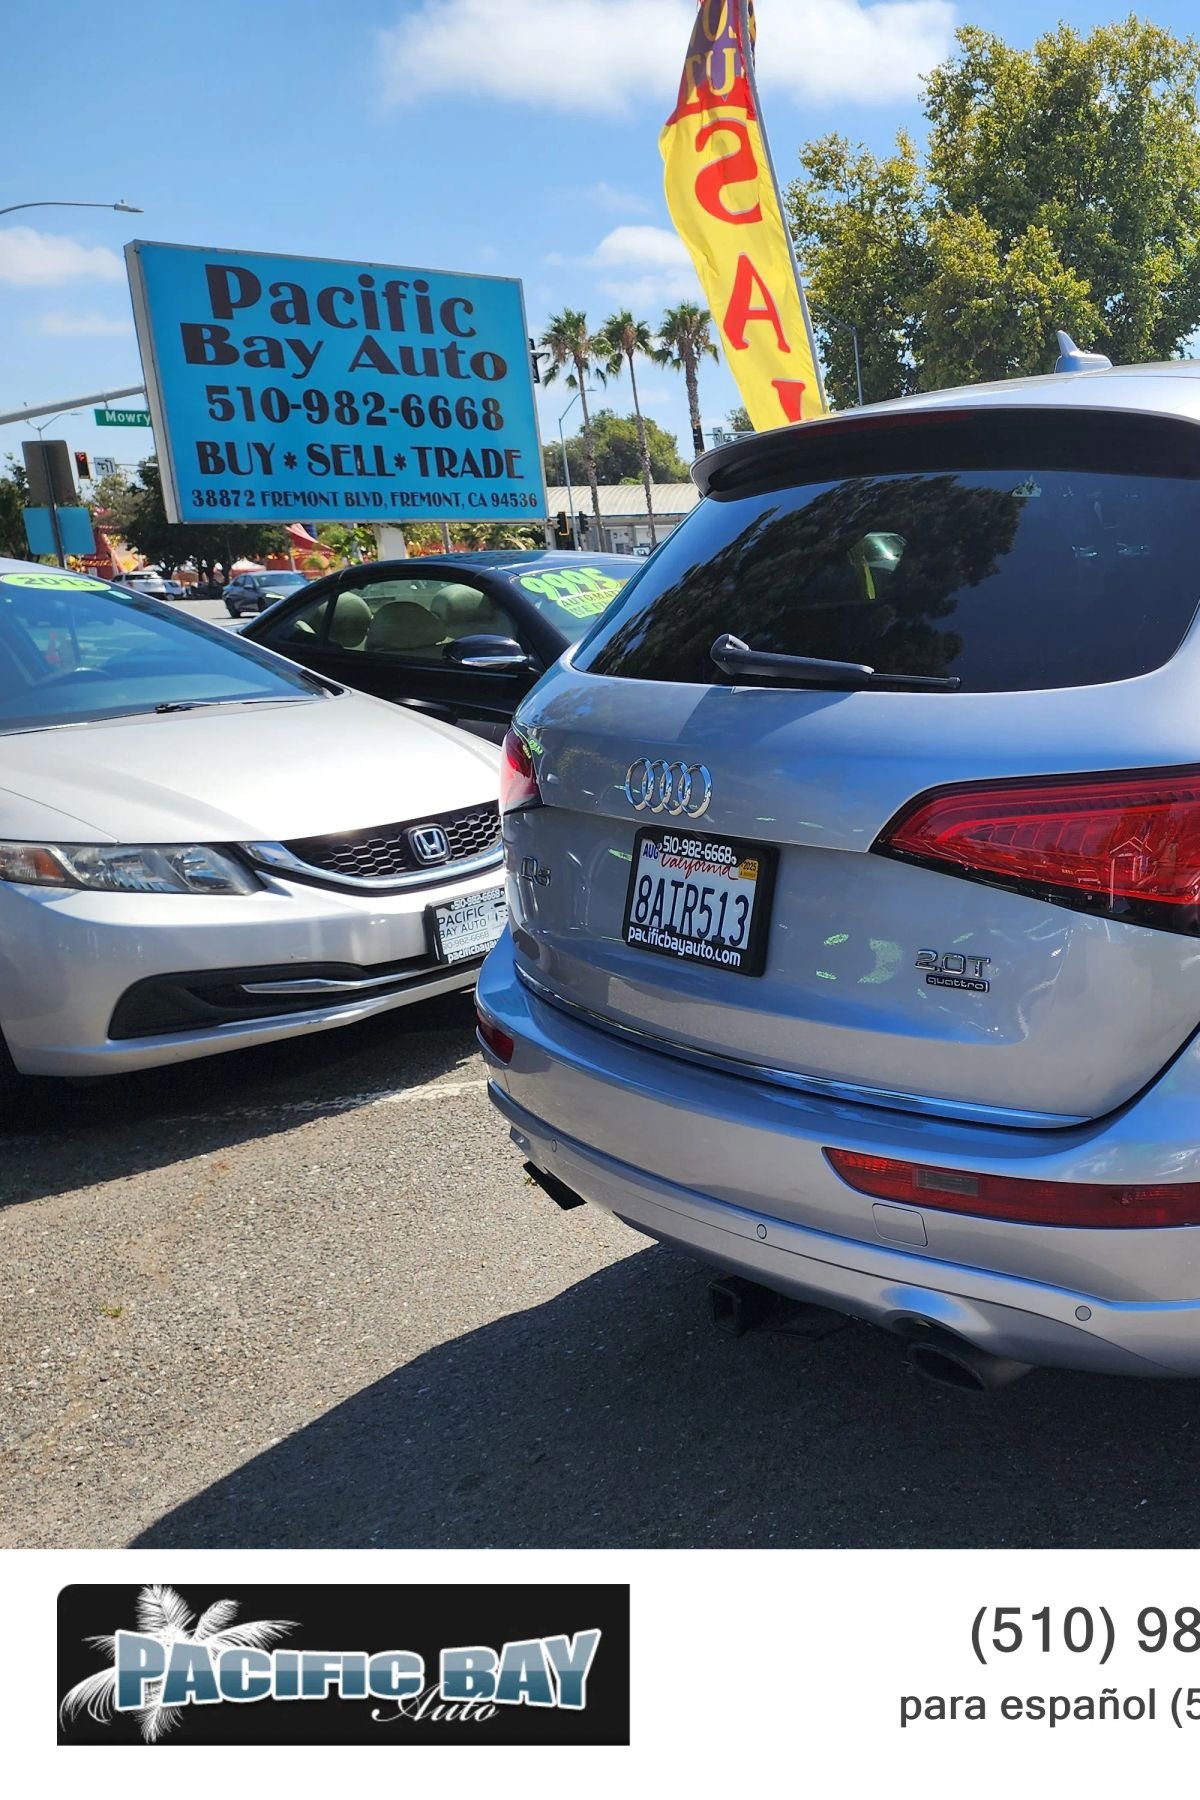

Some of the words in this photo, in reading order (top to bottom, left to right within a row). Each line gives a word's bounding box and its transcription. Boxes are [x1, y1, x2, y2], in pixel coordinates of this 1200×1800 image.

[205, 263, 477, 338] Pacific
[180, 322, 325, 379] Bay
[347, 335, 508, 381] Auto
[104, 410, 150, 426] Mowry
[205, 385, 504, 431] 510-982-6668
[196, 441, 275, 476] BUY
[306, 443, 397, 477] SELL
[410, 446, 525, 479] TRADE
[191, 489, 256, 507] 38872
[260, 490, 339, 507] FREMONT
[344, 491, 388, 509] BLVD,
[390, 492, 465, 509] FREMONT,
[468, 492, 488, 508] CA
[491, 492, 538, 508] 94536
[520, 567, 620, 601] 9995
[642, 843, 659, 860] AUG
[742, 861, 757, 872] 2025
[663, 835, 732, 864] 510-982-6668
[438, 905, 485, 927] PACIFIC
[635, 874, 749, 947] 8AIR513
[440, 925, 461, 940] BAY
[461, 918, 487, 934] AUTO
[628, 925, 741, 967] pacificbayauto.com
[915, 948, 992, 978] 2.0T
[927, 976, 984, 991] quattro
